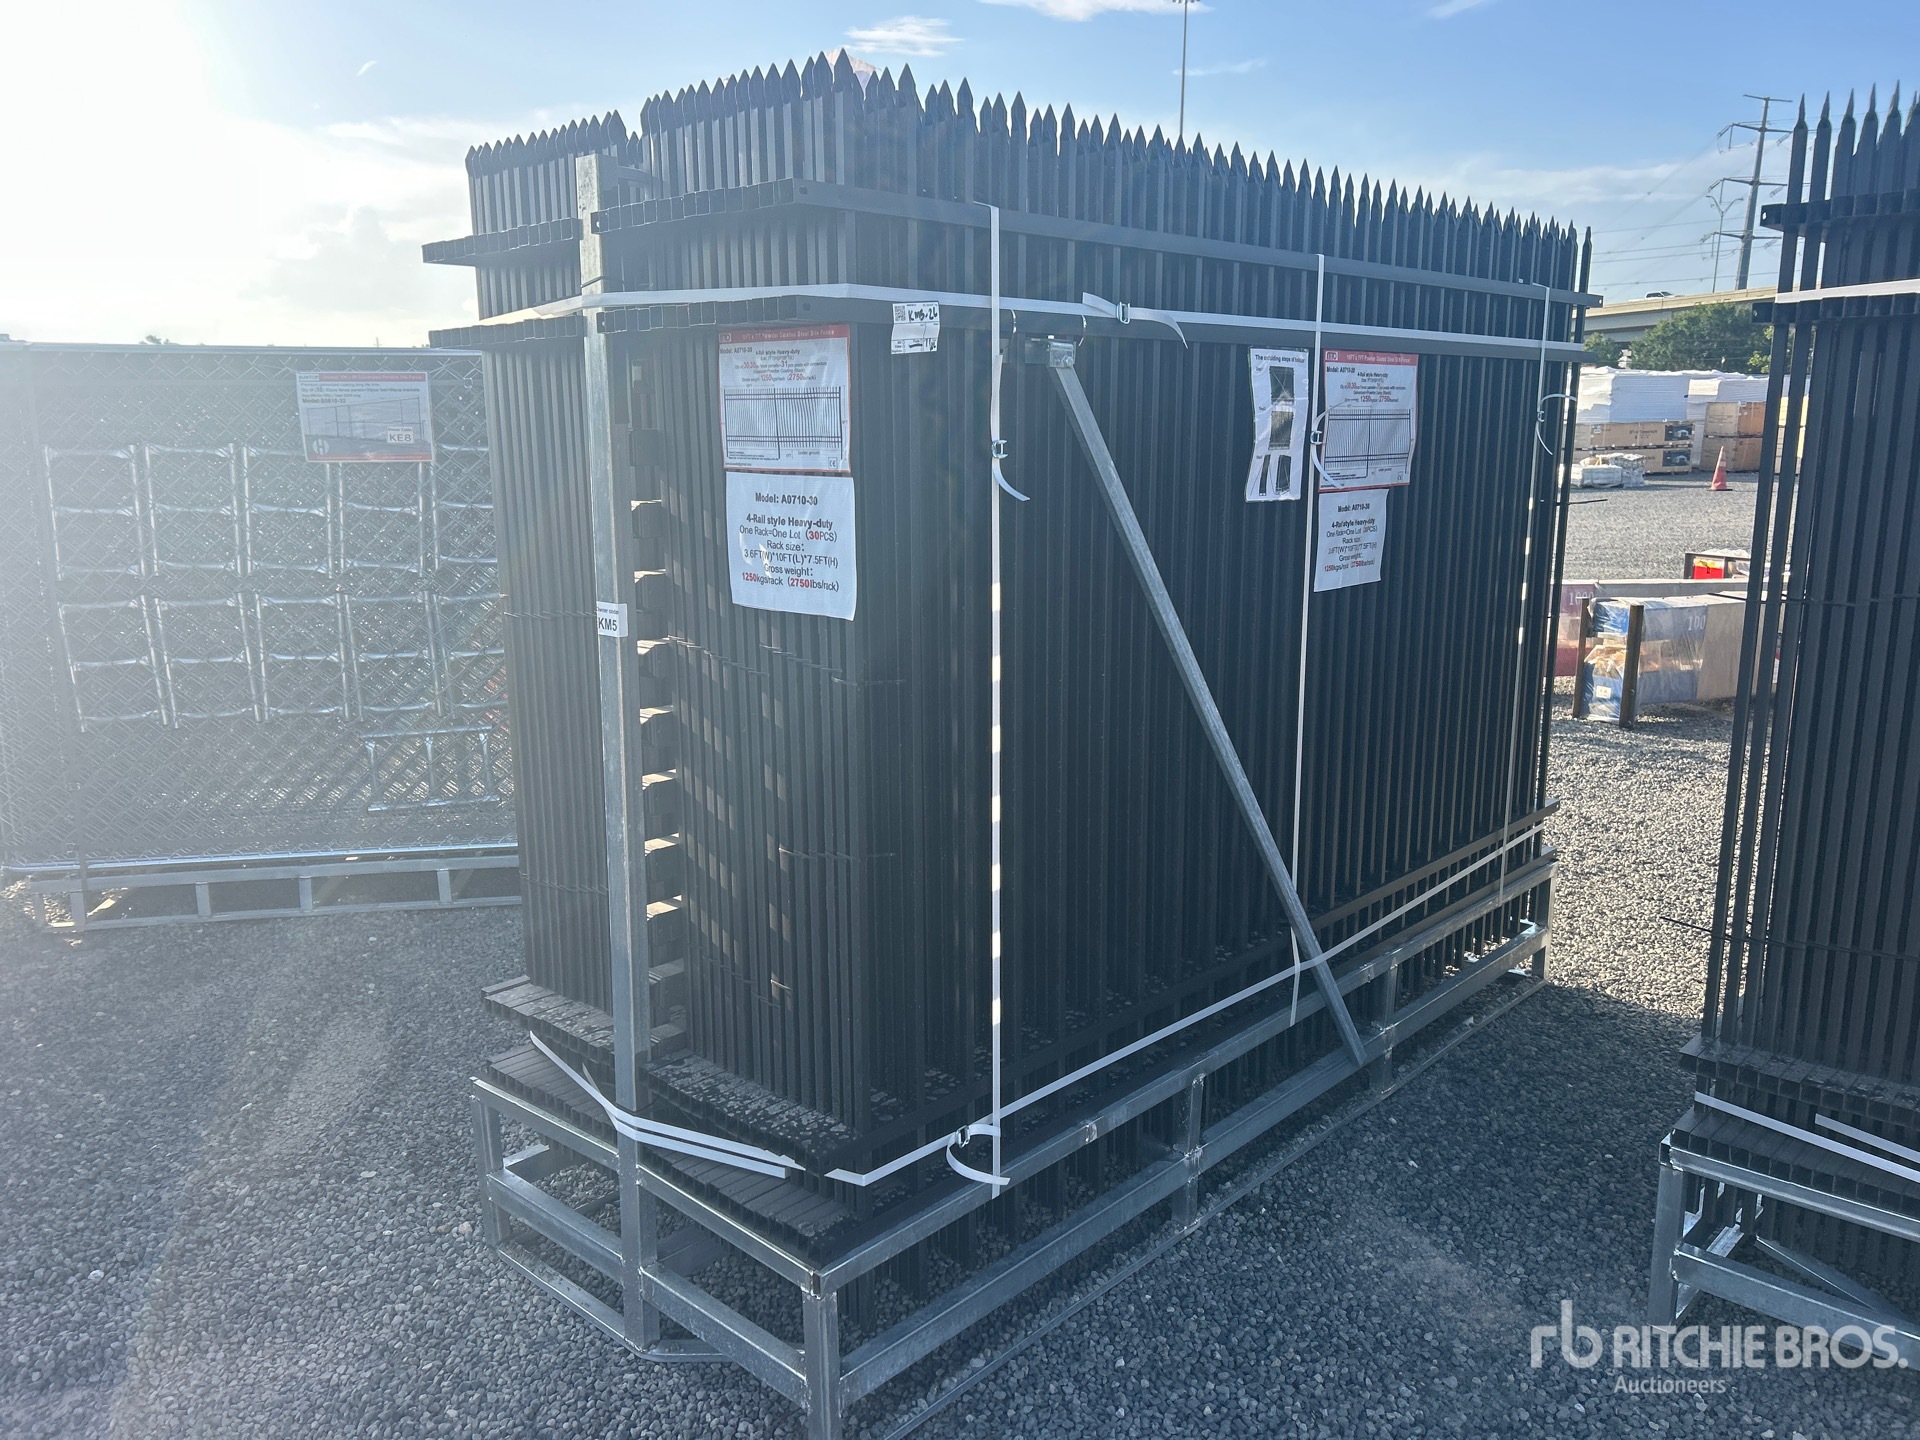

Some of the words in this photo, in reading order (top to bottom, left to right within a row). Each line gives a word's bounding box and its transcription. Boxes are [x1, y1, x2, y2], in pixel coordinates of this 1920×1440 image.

[755, 493, 779, 504] Model:
[781, 494, 818, 506] A0710-30
[746, 513, 766, 524] 4-Rail
[767, 516, 786, 527] style
[788, 517, 833, 531] Heavy-duty
[739, 525, 753, 534] One
[754, 526, 787, 539] Rack=One
[790, 530, 801, 539] Lot
[805, 530, 837, 542] (30PCS)
[767, 540, 784, 550] Rack
[764, 563, 783, 574] Gross
[784, 566, 813, 576] weight:
[788, 577, 839, 592] (2750lbs/rack)
[598, 617, 617, 631] KM5
